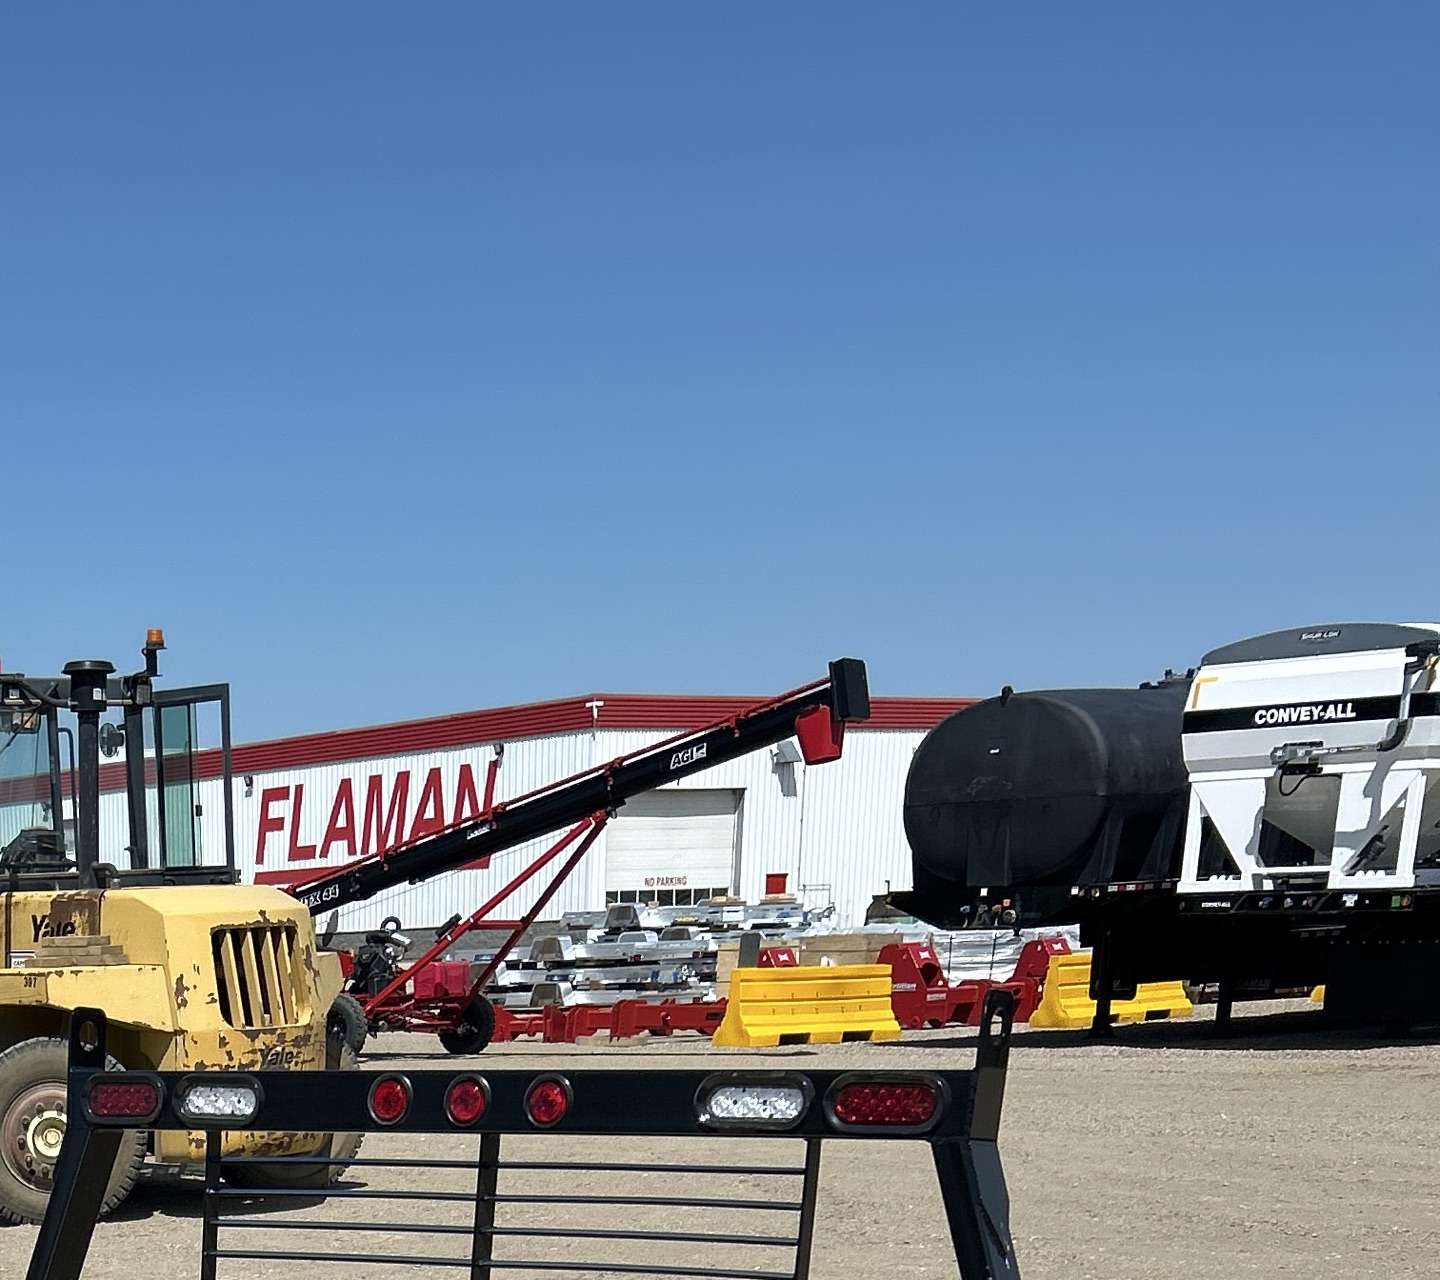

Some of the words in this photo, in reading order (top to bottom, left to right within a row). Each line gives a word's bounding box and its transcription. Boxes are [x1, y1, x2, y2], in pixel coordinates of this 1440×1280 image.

[1254, 702, 1356, 724] CONVEY-ALL
[670, 746, 695, 769] AGI
[255, 760, 498, 865] FLAMAN
[644, 877, 655, 887] NO
[656, 875, 688, 886] PARKING
[31, 914, 76, 943] Yale
[259, 1043, 295, 1066] Yale
